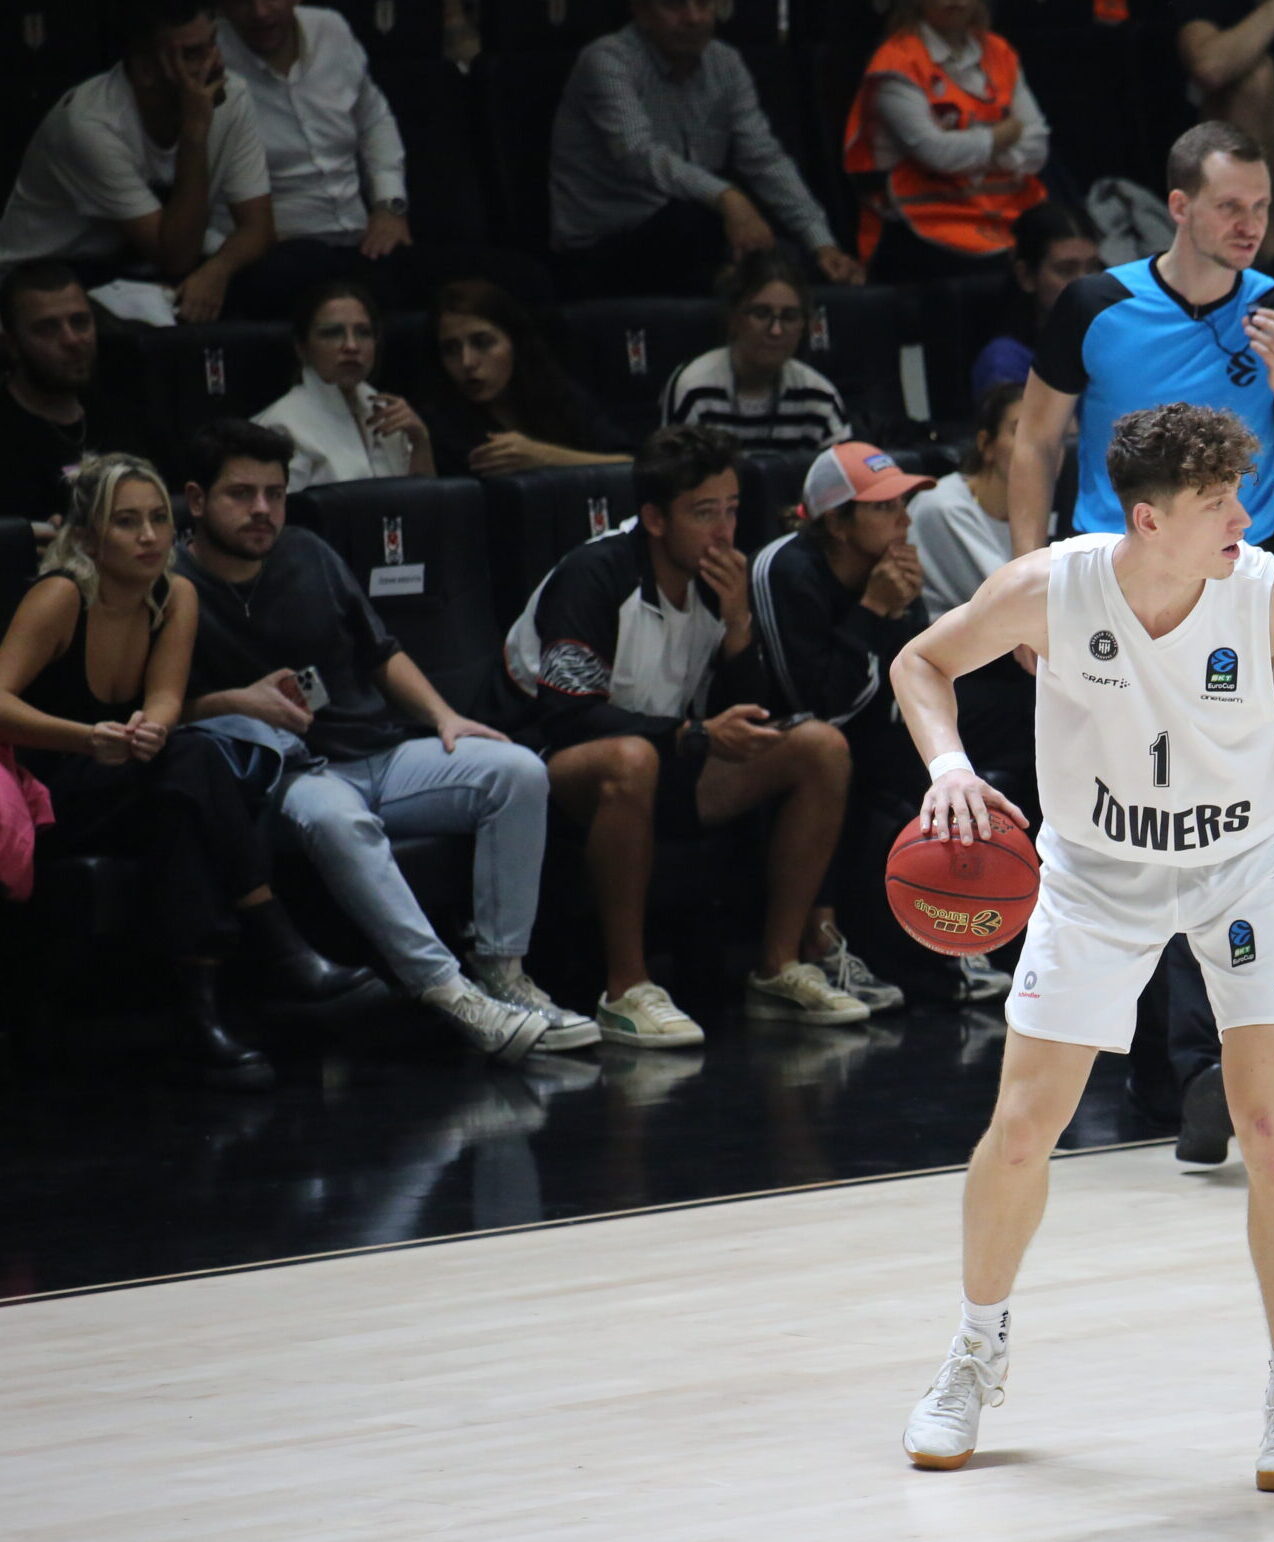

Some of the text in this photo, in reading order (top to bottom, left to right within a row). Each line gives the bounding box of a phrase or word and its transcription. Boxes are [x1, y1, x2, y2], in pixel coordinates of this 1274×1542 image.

[1082, 672, 1119, 686] CRAFT
[1207, 682, 1236, 690] EuroCup
[1149, 731, 1170, 787] 1
[1092, 776, 1251, 851] TOWERS
[914, 899, 970, 926] EuroCup
[1232, 953, 1255, 965] EuroCup
